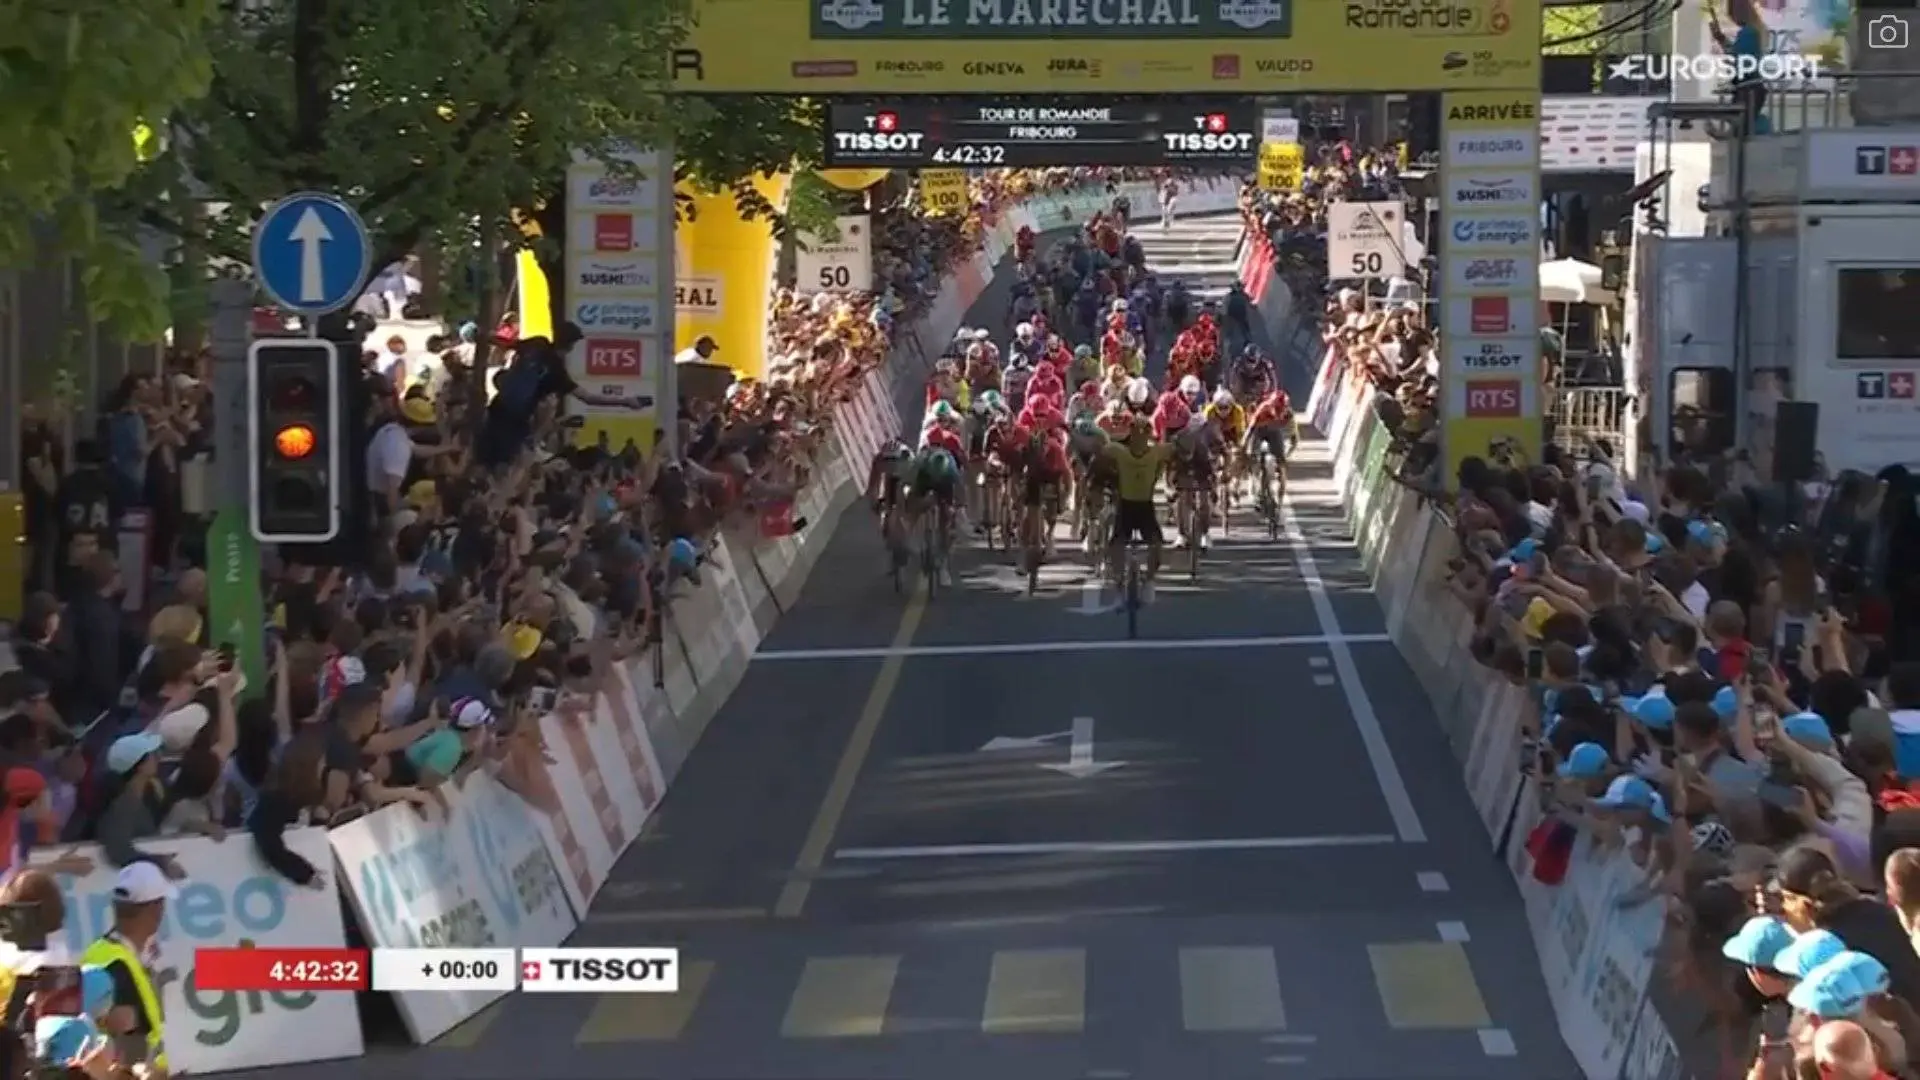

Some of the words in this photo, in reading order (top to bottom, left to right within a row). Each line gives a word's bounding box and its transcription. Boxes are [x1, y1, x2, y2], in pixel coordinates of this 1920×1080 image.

[901, 0, 950, 26] LE
[962, 62, 1025, 76] GENEVA
[1046, 58, 1089, 72] JURA
[979, 108, 1016, 121] TOUR
[1018, 108, 1035, 121] DE
[1039, 107, 1111, 121] ROMANDIE
[1448, 100, 1535, 120] ARRIVÉE
[1009, 126, 1078, 138] FRIBOURG
[834, 132, 924, 150] TISSOT
[1163, 132, 1252, 151] TISSOT
[1459, 140, 1524, 153] FRIBOURG
[931, 146, 1005, 163] 4:42:32
[1267, 174, 1295, 189] 100
[931, 191, 959, 206] 100
[1476, 231, 1530, 245] energie
[1351, 251, 1383, 275] 50
[820, 265, 851, 288] 50
[591, 347, 637, 367] RTS
[1463, 354, 1523, 367] TISSOT
[1470, 389, 1517, 408] RTS
